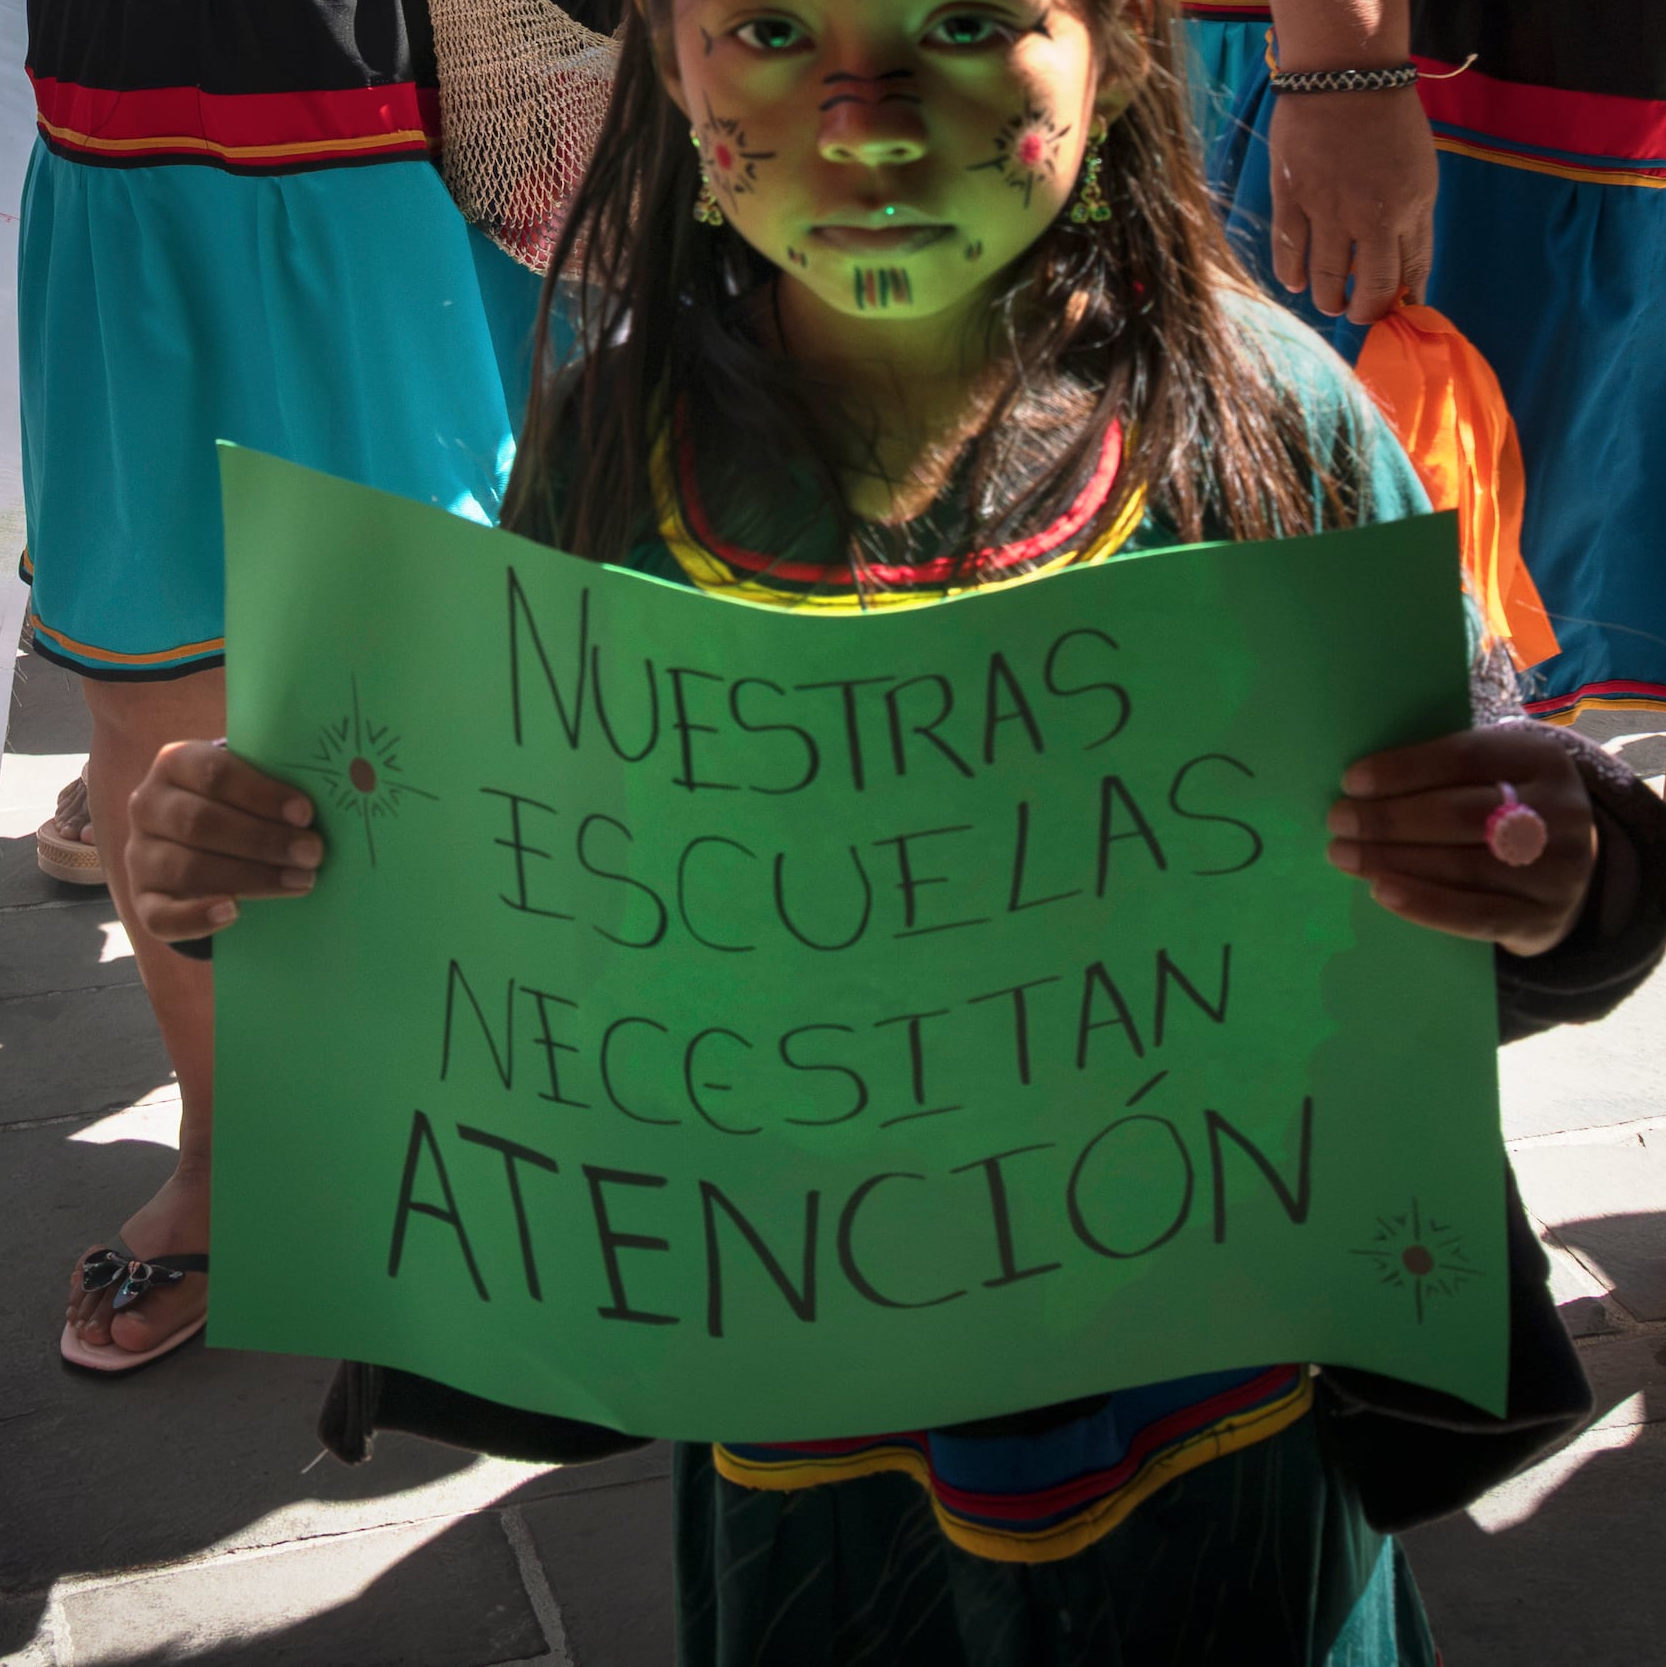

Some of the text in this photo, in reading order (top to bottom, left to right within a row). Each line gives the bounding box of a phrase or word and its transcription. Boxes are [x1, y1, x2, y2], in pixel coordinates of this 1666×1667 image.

[506, 565, 1132, 794] NUESTRAS
[479, 752, 1265, 952] ESCUELAS
[439, 942, 1232, 1134] NECESITAN
[387, 1070, 1314, 1338] ATENCIÓN
